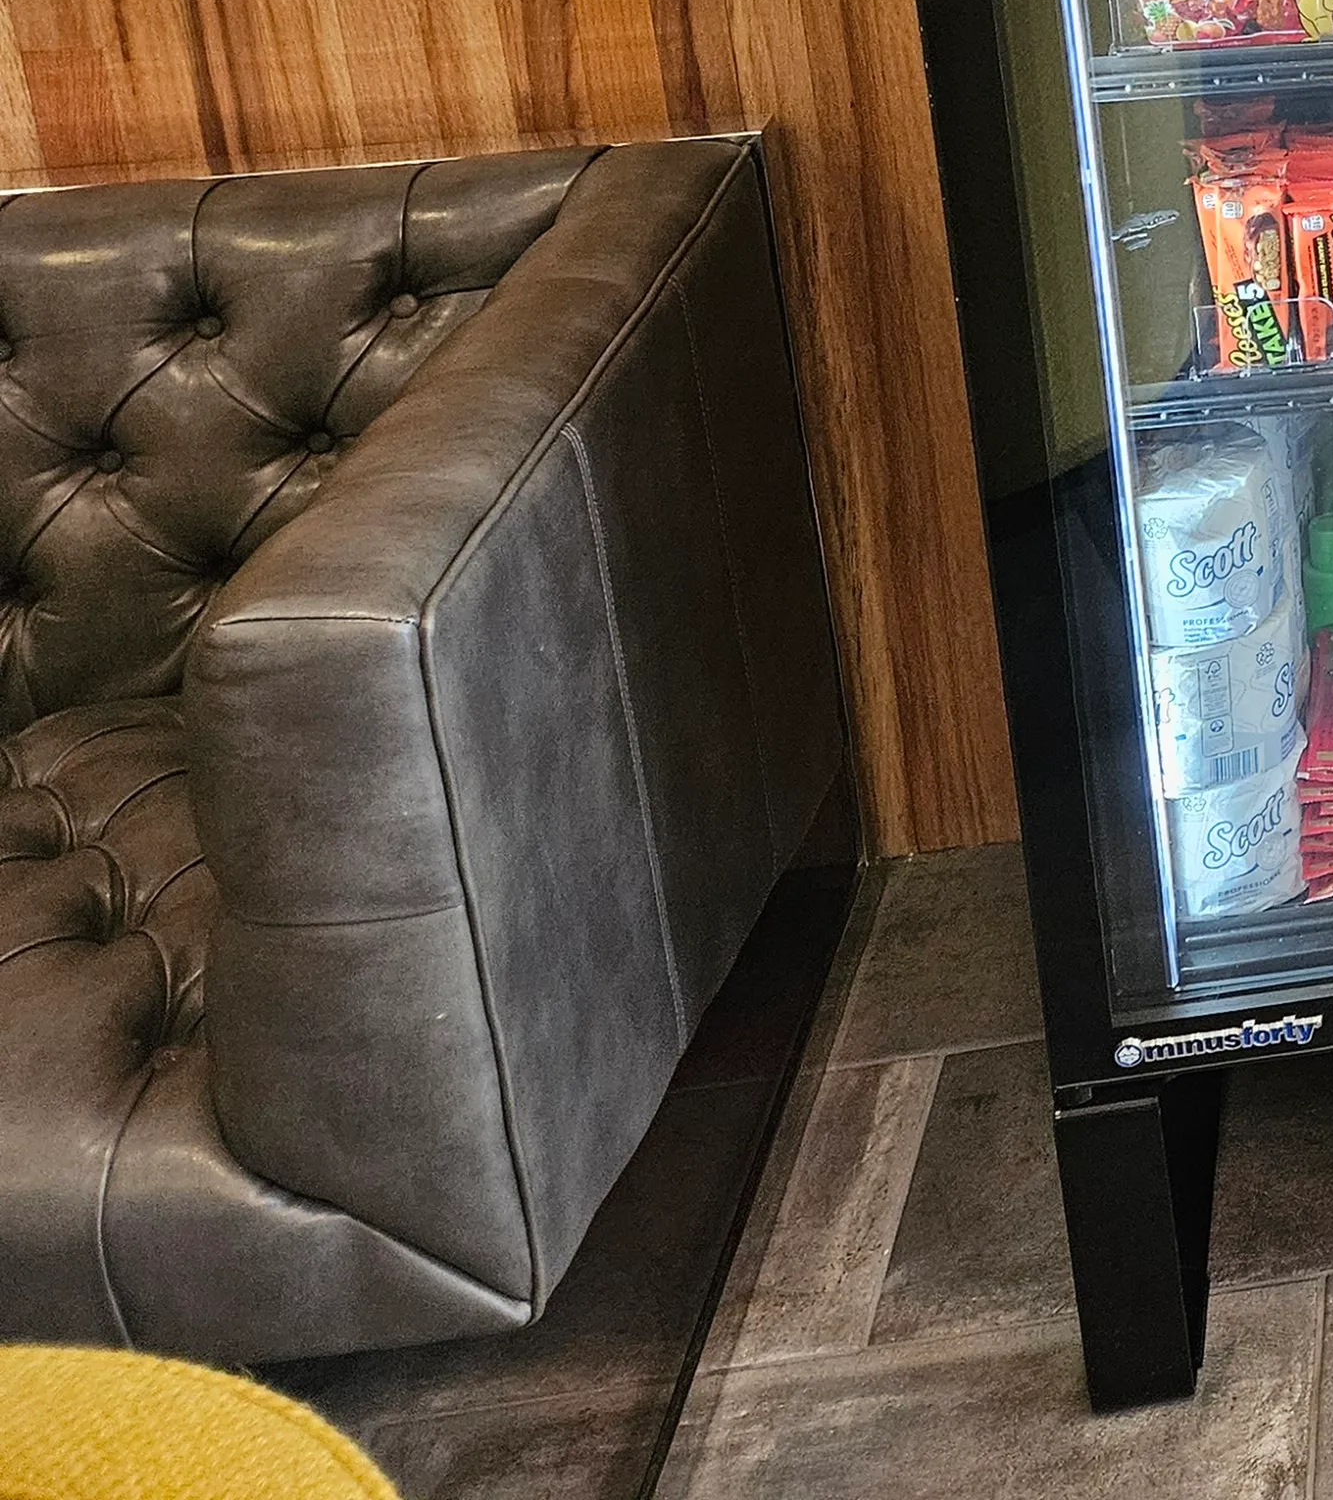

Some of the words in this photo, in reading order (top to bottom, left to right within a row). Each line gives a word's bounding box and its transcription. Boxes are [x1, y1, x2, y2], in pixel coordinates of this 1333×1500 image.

[1237, 283, 1264, 301] 5
[1251, 301, 1286, 366] TAKE
[1166, 521, 1257, 598] Scott
[1182, 608, 1251, 628] PROFESSIONAL
[1203, 787, 1284, 870] Scott
[1217, 868, 1283, 899] PROFESSIONAL
[1144, 1014, 1323, 1063] minusforty
